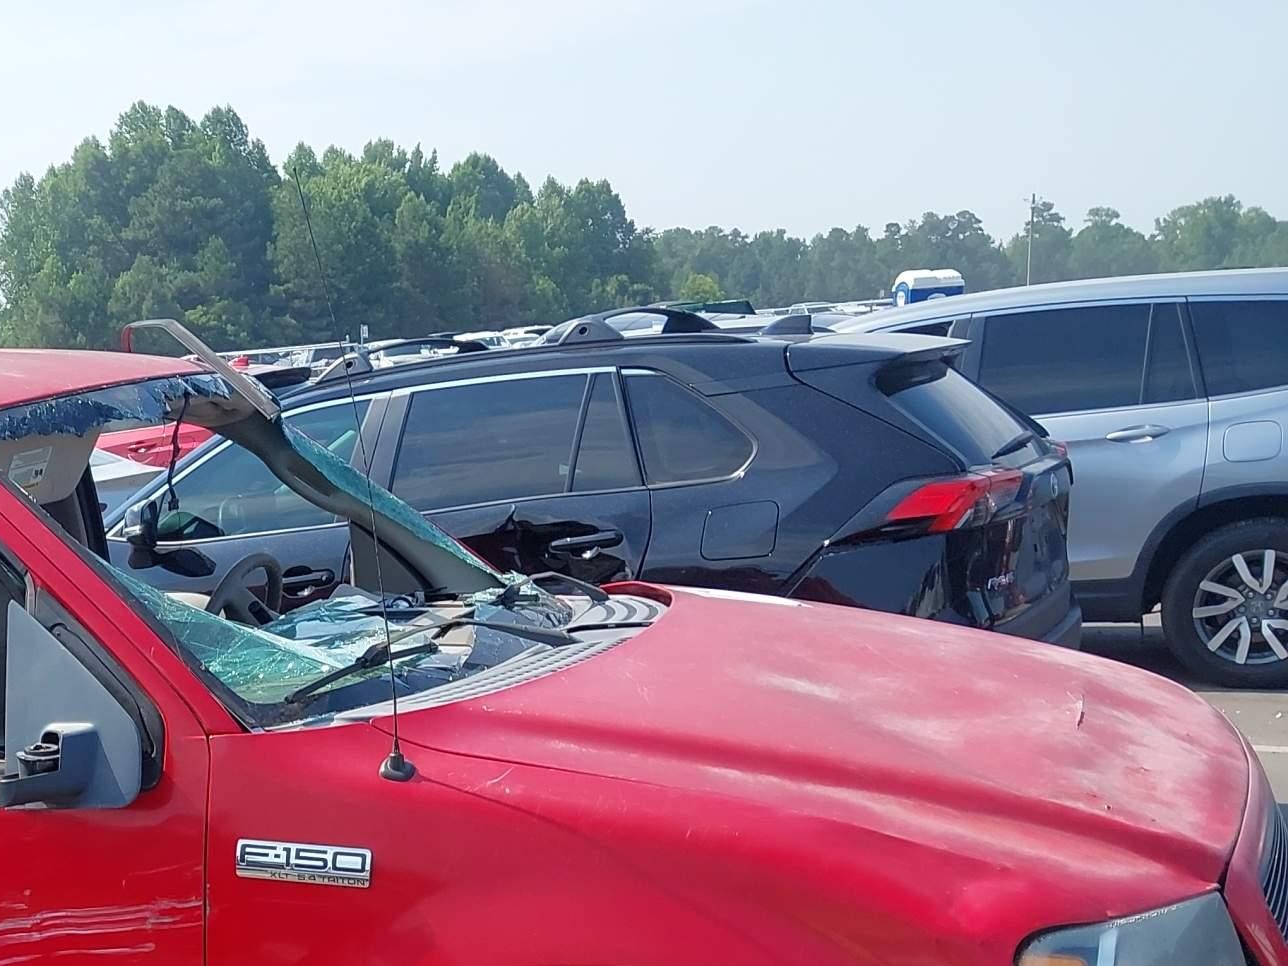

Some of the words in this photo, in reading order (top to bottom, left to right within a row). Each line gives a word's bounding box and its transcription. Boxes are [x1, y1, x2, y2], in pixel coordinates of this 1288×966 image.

[239, 843, 367, 874] F-150
[269, 871, 291, 880] XLT
[320, 875, 365, 886] TRITON
